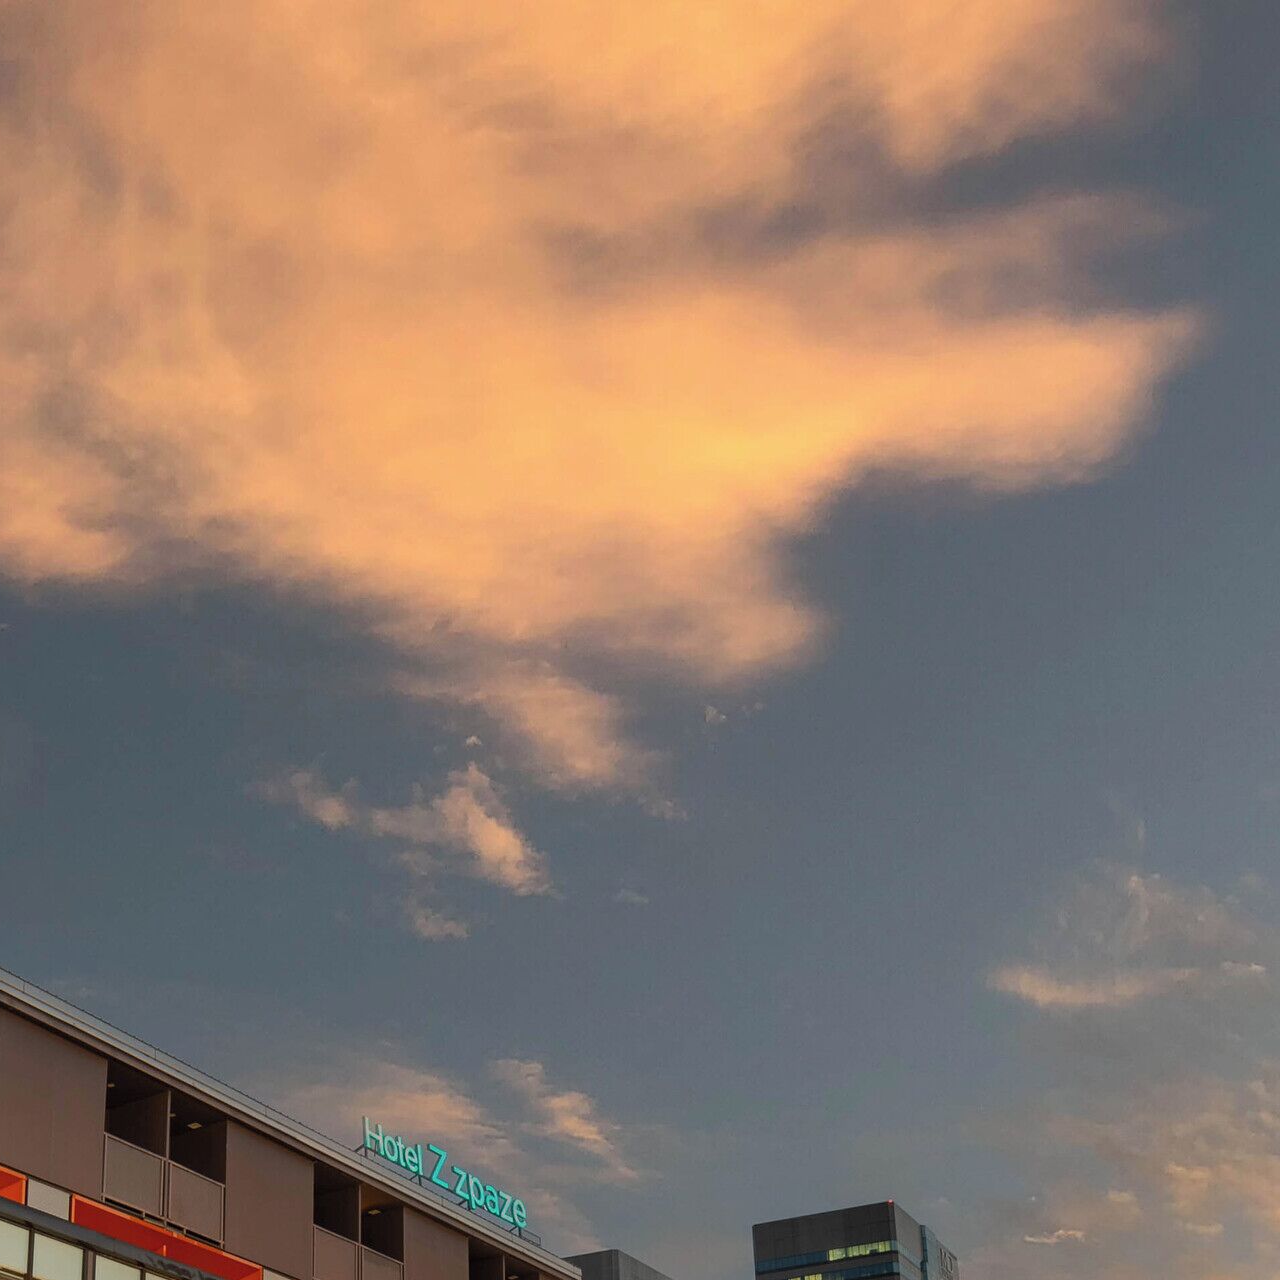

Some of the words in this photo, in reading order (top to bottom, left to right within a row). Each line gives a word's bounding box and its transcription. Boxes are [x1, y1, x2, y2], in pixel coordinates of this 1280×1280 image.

[363, 1115, 424, 1176] Hotel
[427, 1143, 450, 1190] Z
[451, 1165, 528, 1229] zpaze
